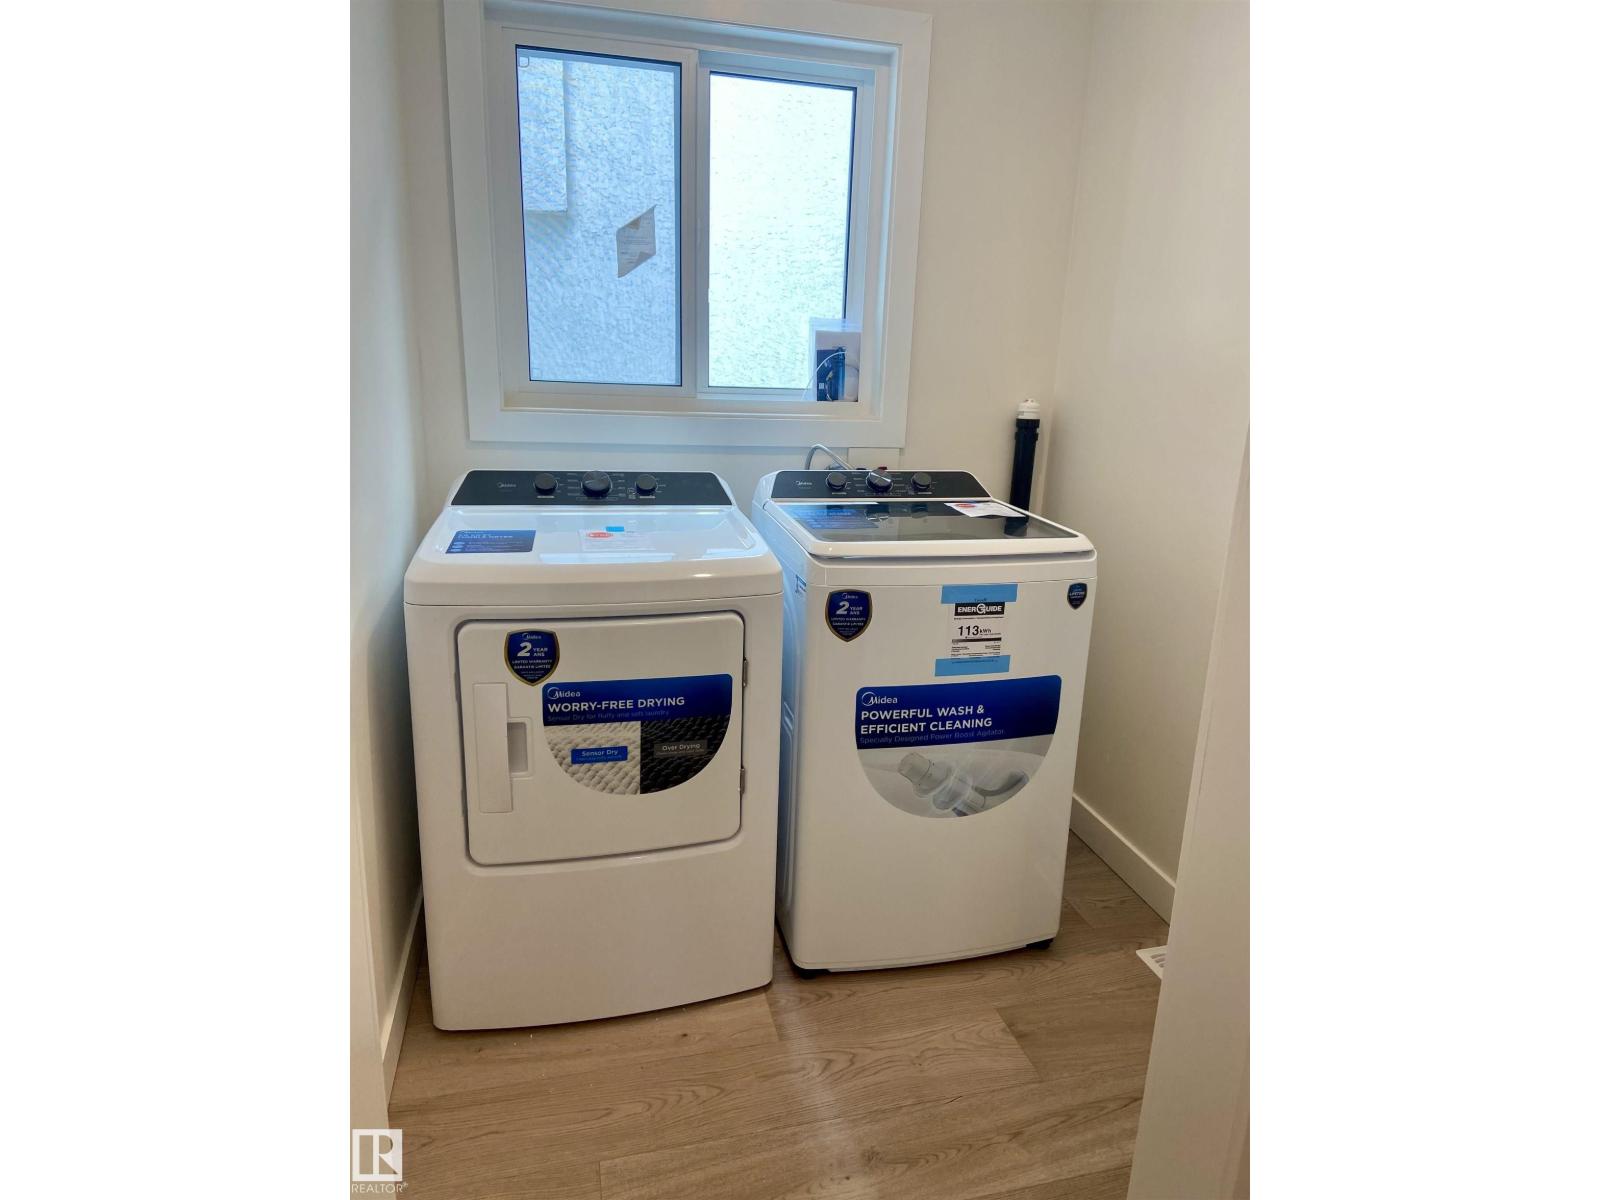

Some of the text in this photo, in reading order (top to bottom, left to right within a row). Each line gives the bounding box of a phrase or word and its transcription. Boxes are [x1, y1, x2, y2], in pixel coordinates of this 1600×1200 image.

[835, 600, 850, 615] 2
[957, 603, 1003, 614] ENERGUIDE
[958, 625, 980, 636] 113
[517, 641, 532, 657] 2
[547, 686, 581, 700] Midea
[861, 691, 898, 707] Midea
[547, 696, 686, 713] WORRY-FREE DRYING
[861, 704, 985, 721] POWERFUL WASH &
[860, 717, 993, 735] EFFICIENT CLEANING
[894, 734, 929, 743] Designed
[679, 743, 702, 751] Drying
